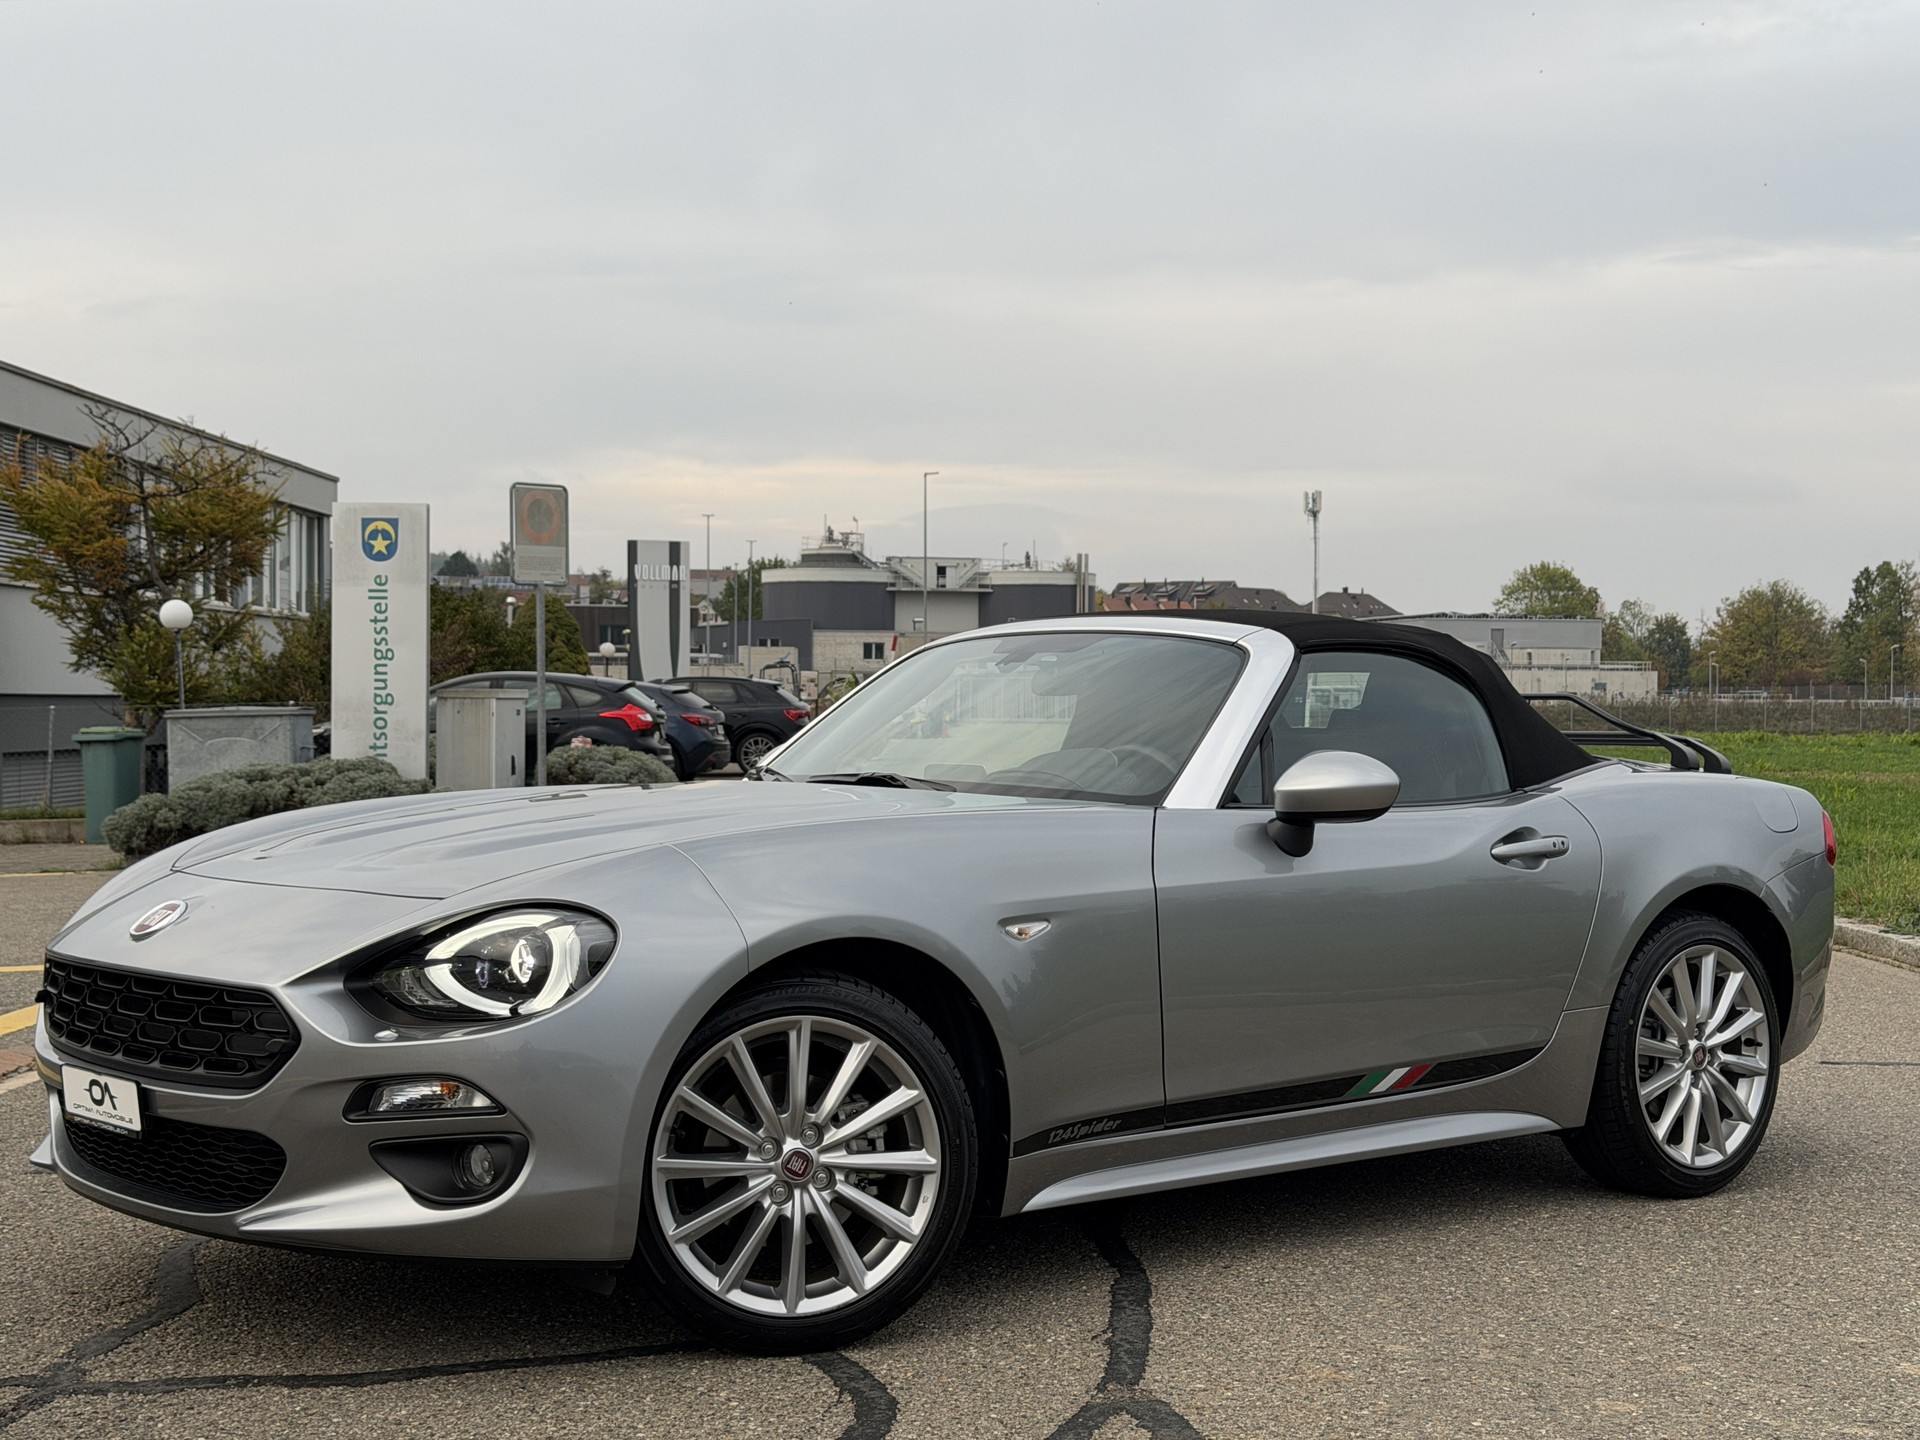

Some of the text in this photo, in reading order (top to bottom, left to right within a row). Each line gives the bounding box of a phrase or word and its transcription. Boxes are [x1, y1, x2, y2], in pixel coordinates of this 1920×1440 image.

[634, 564, 686, 581] VOLLMAR
[96, 1109, 134, 1125] AUTOMOBILE
[786, 1155, 807, 1175] FIAT
